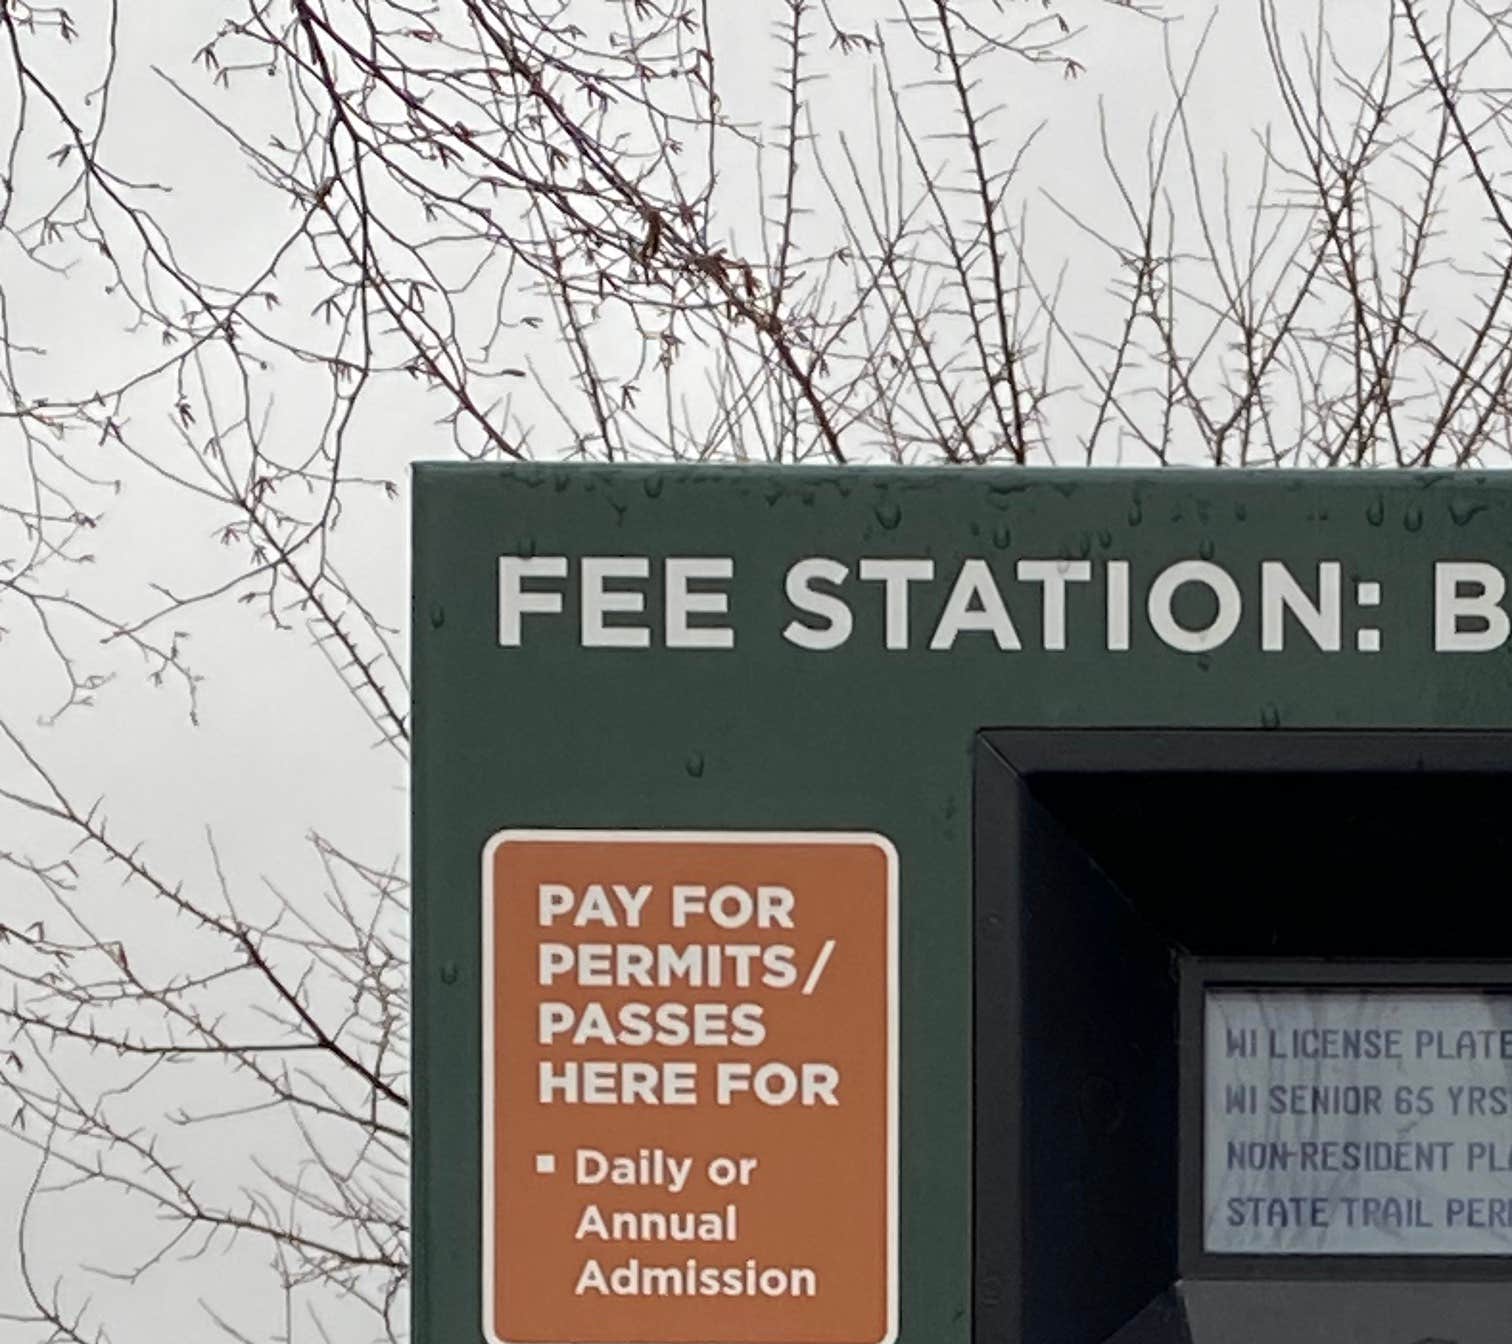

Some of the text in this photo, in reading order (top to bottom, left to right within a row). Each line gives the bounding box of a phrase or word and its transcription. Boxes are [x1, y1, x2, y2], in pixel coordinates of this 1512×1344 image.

[499, 556, 734, 648] FEE
[783, 558, 1380, 653] STATION:
[539, 884, 795, 929] PAY FOR
[539, 939, 836, 995] PERMITS/
[539, 1002, 766, 1046] PASSES
[1225, 1031, 1257, 1060] WI
[1269, 1031, 1402, 1060] LICENSE
[539, 1061, 839, 1106] HERE FOR
[1225, 1086, 1508, 1115] WI SENIOR 65 YRS
[576, 1148, 757, 1193] Daily or
[1227, 1143, 1452, 1173] NON-RESIDENT
[575, 1204, 737, 1241] Annual
[1227, 1198, 1327, 1229] STATE
[1341, 1198, 1433, 1228] TRAIL
[575, 1258, 816, 1297] Admission
